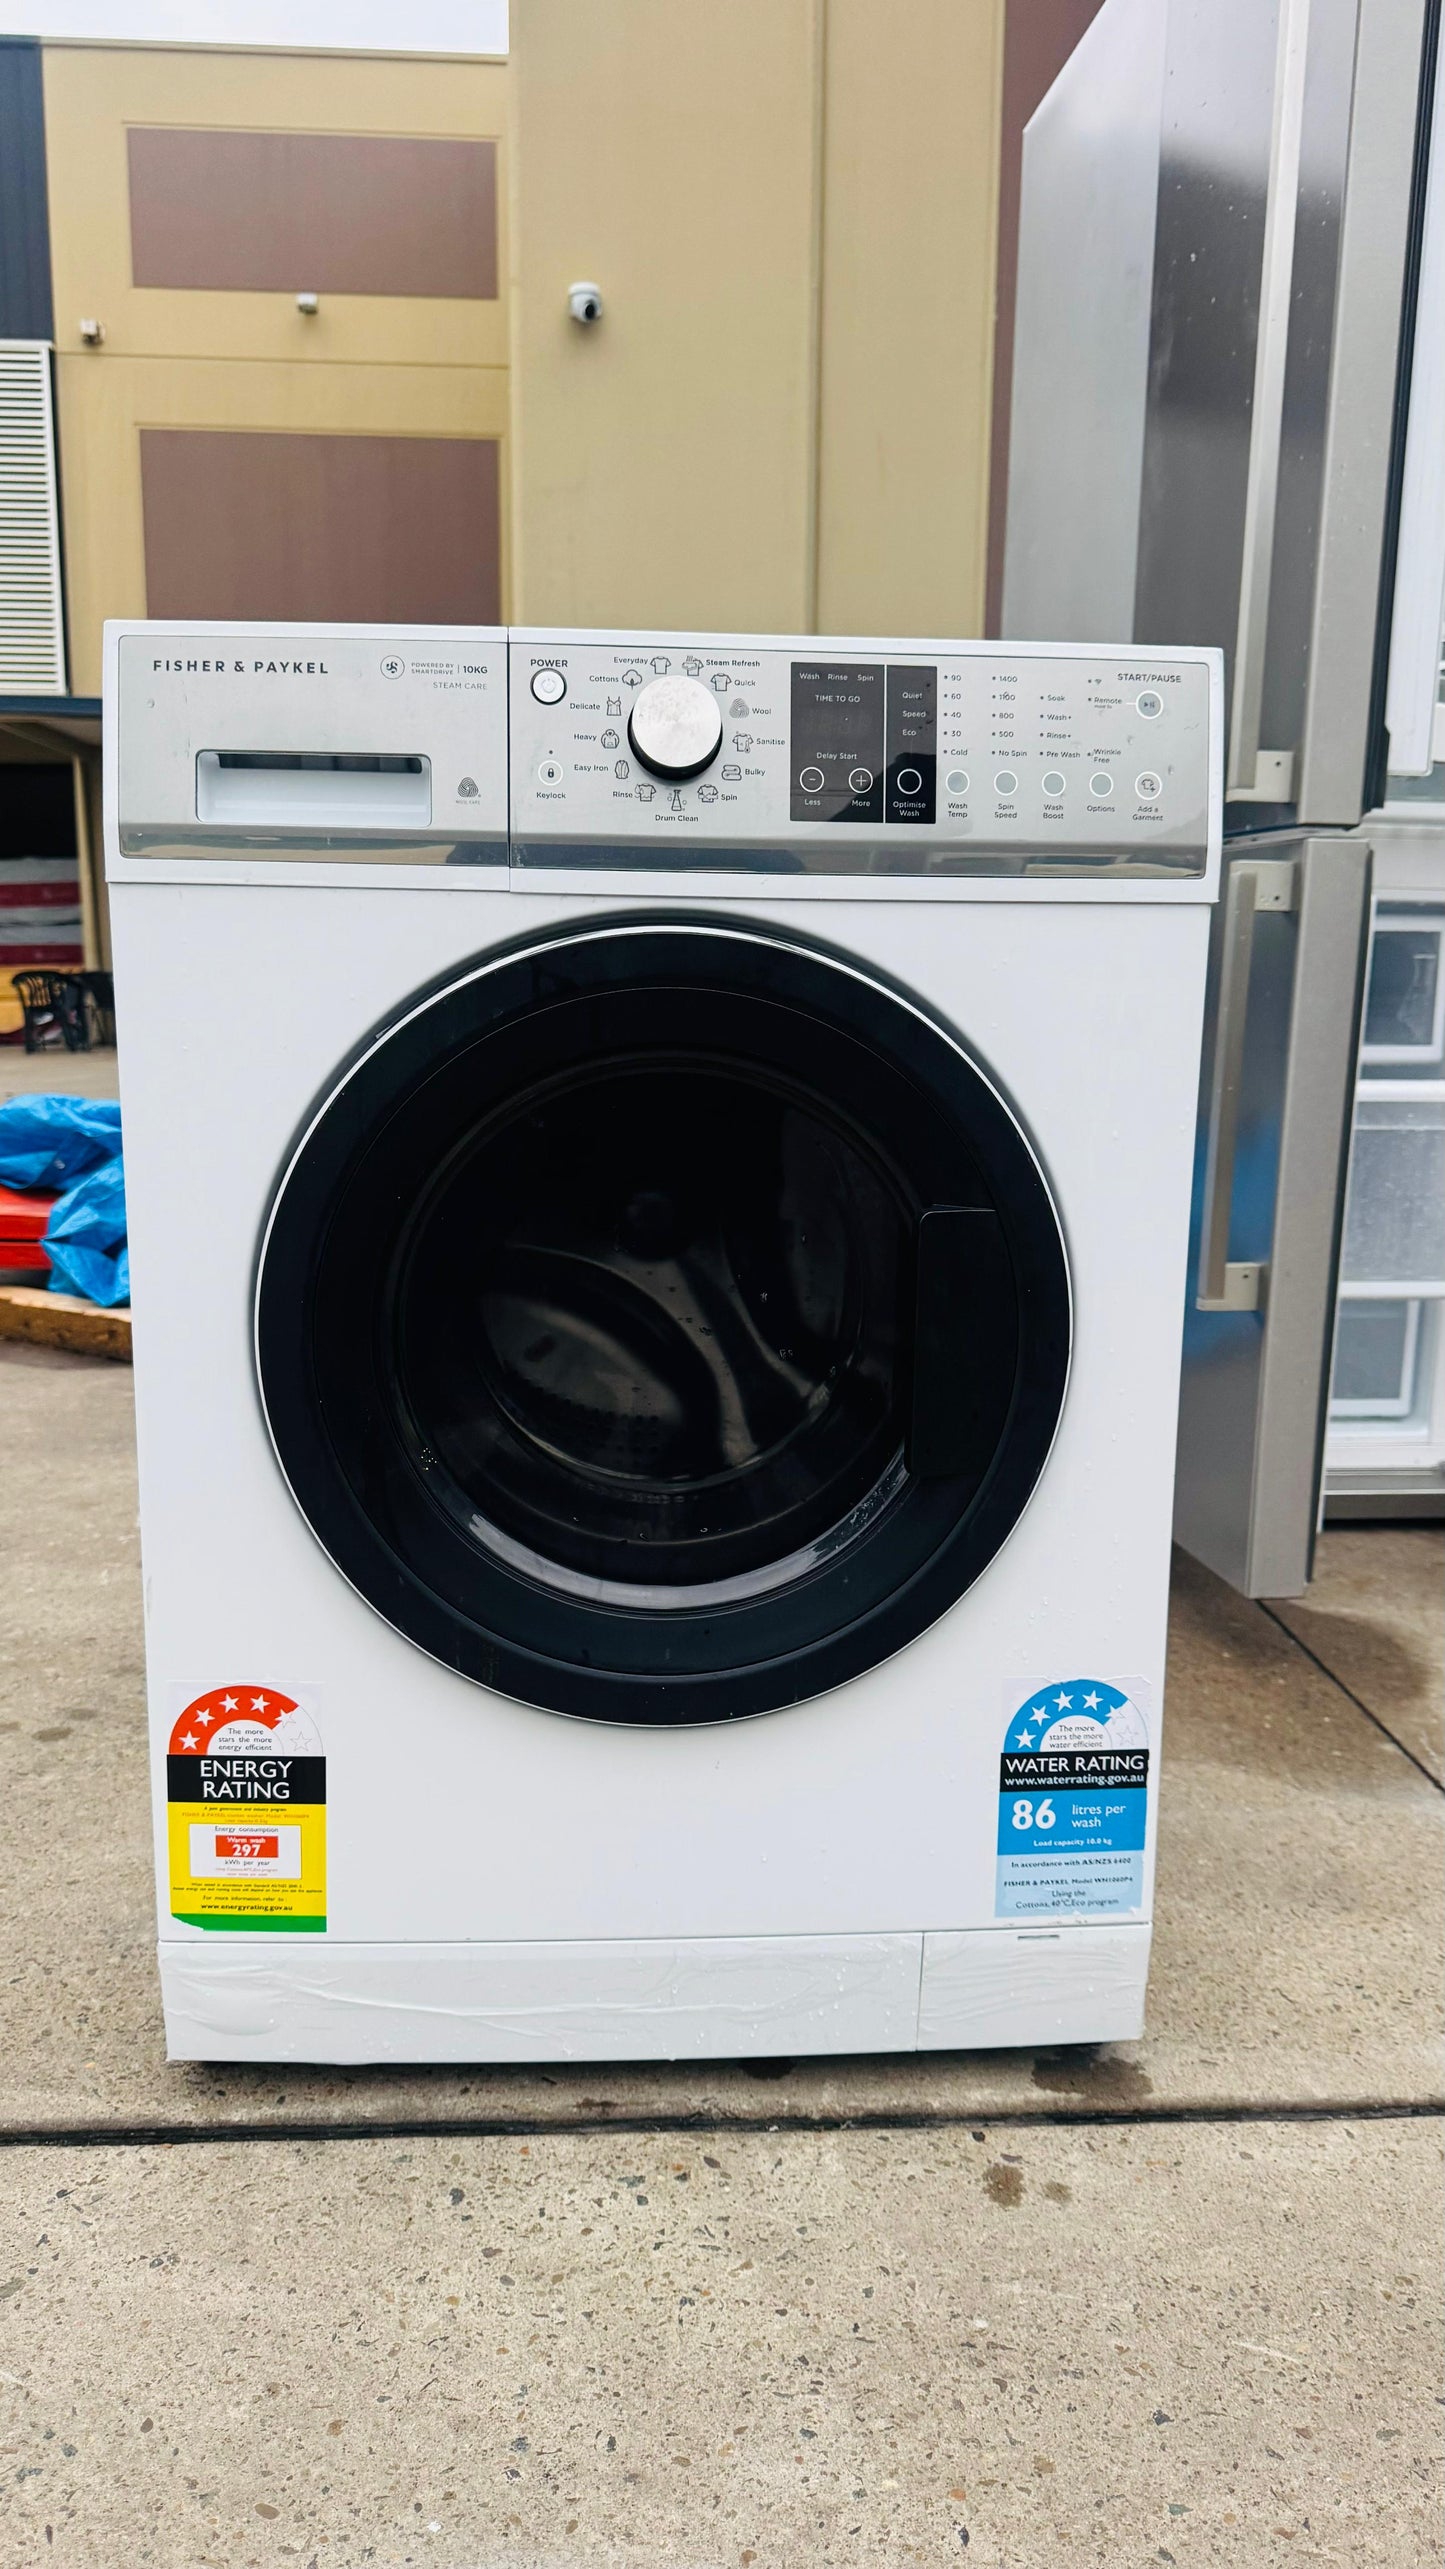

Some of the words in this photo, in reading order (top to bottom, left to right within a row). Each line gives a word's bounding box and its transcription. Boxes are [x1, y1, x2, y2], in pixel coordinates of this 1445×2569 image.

[530, 659, 568, 667] POWER
[614, 657, 648, 665] Everyday
[153, 660, 226, 672] FISHER
[234, 661, 245, 672] &
[254, 661, 329, 673] PAYKEL
[828, 673, 848, 681] Rinse
[857, 674, 874, 682] Spin
[999, 675, 1018, 683] 1400
[1117, 674, 1181, 683] START/PAUSE
[734, 679, 755, 687] Quick
[902, 692, 922, 700] Quiet
[1047, 694, 1065, 702] Soak
[1094, 697, 1122, 705] Remote
[570, 702, 600, 710] Delicate
[752, 707, 771, 715] Wool
[902, 710, 926, 719] Speed
[574, 733, 597, 742] Heavy
[817, 752, 837, 760] Delay
[1012, 750, 1027, 758] Spin
[1060, 751, 1080, 759] Wash
[574, 764, 591, 772] Easy
[745, 768, 765, 777] Bulky
[537, 792, 566, 800] Keylock
[721, 794, 737, 802] Spin
[893, 801, 926, 809] Optimise
[948, 802, 967, 810] Wash
[998, 803, 1014, 812] Spin
[1044, 804, 1064, 812] Wash
[1138, 805, 1152, 813] Add
[899, 809, 920, 817] Wash
[1087, 805, 1115, 814] Options
[948, 811, 967, 819] Temp
[995, 812, 1017, 820] Speed
[1043, 812, 1064, 820] Boost
[1132, 813, 1163, 821] Garment
[219, 1744, 241, 1752] energy
[1006, 1758, 1070, 1773] WATER
[1076, 1755, 1145, 1771] RATING
[200, 1760, 293, 1779] ENERGY
[1005, 1775, 1144, 1786] www.waterrating.gov.au
[203, 1782, 290, 1799] RATING
[1072, 1804, 1102, 1815] litres
[1106, 1805, 1126, 1816] per
[1012, 1799, 1056, 1830] 86
[1072, 1818, 1101, 1828] wash
[239, 1826, 278, 1834] consumption
[233, 1844, 260, 1857] 297
[1052, 1890, 1072, 1898] Using
[1088, 1899, 1118, 1907] program
